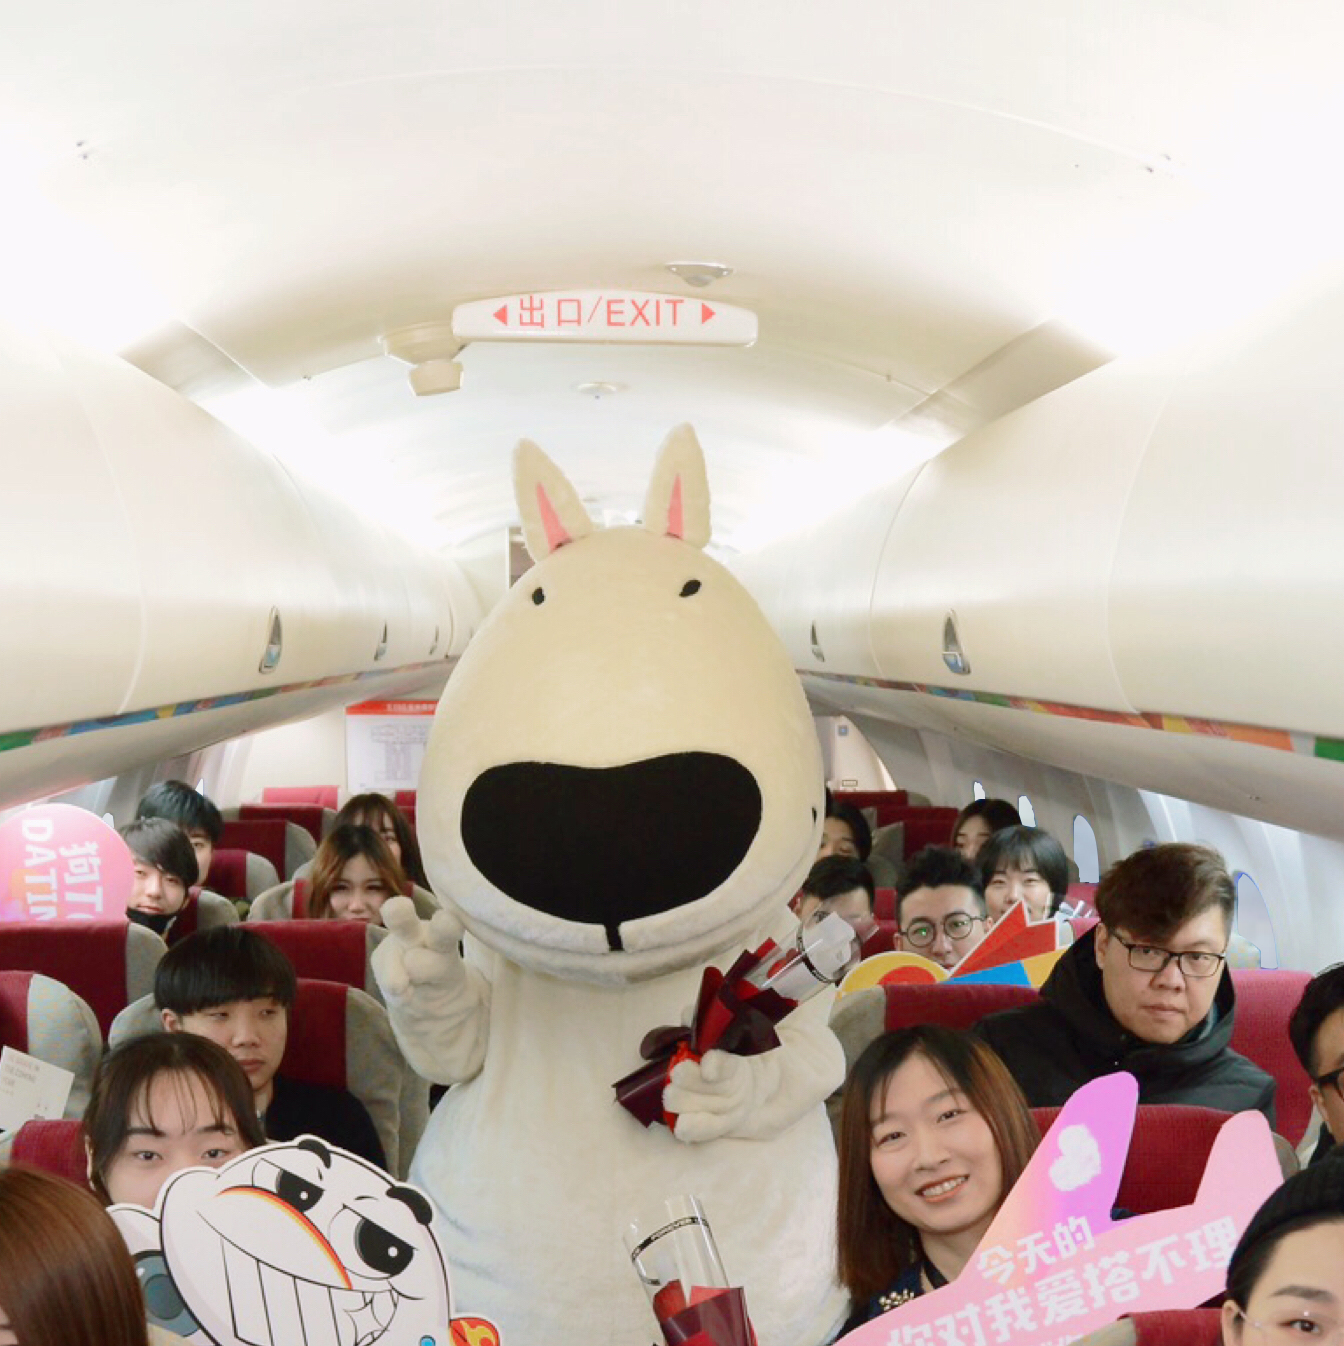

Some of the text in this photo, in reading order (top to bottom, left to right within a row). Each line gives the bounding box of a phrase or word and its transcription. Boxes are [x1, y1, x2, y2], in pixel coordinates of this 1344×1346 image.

[518, 295, 684, 328] 出口/EXIT
[977, 1214, 1096, 1286] 今天的
